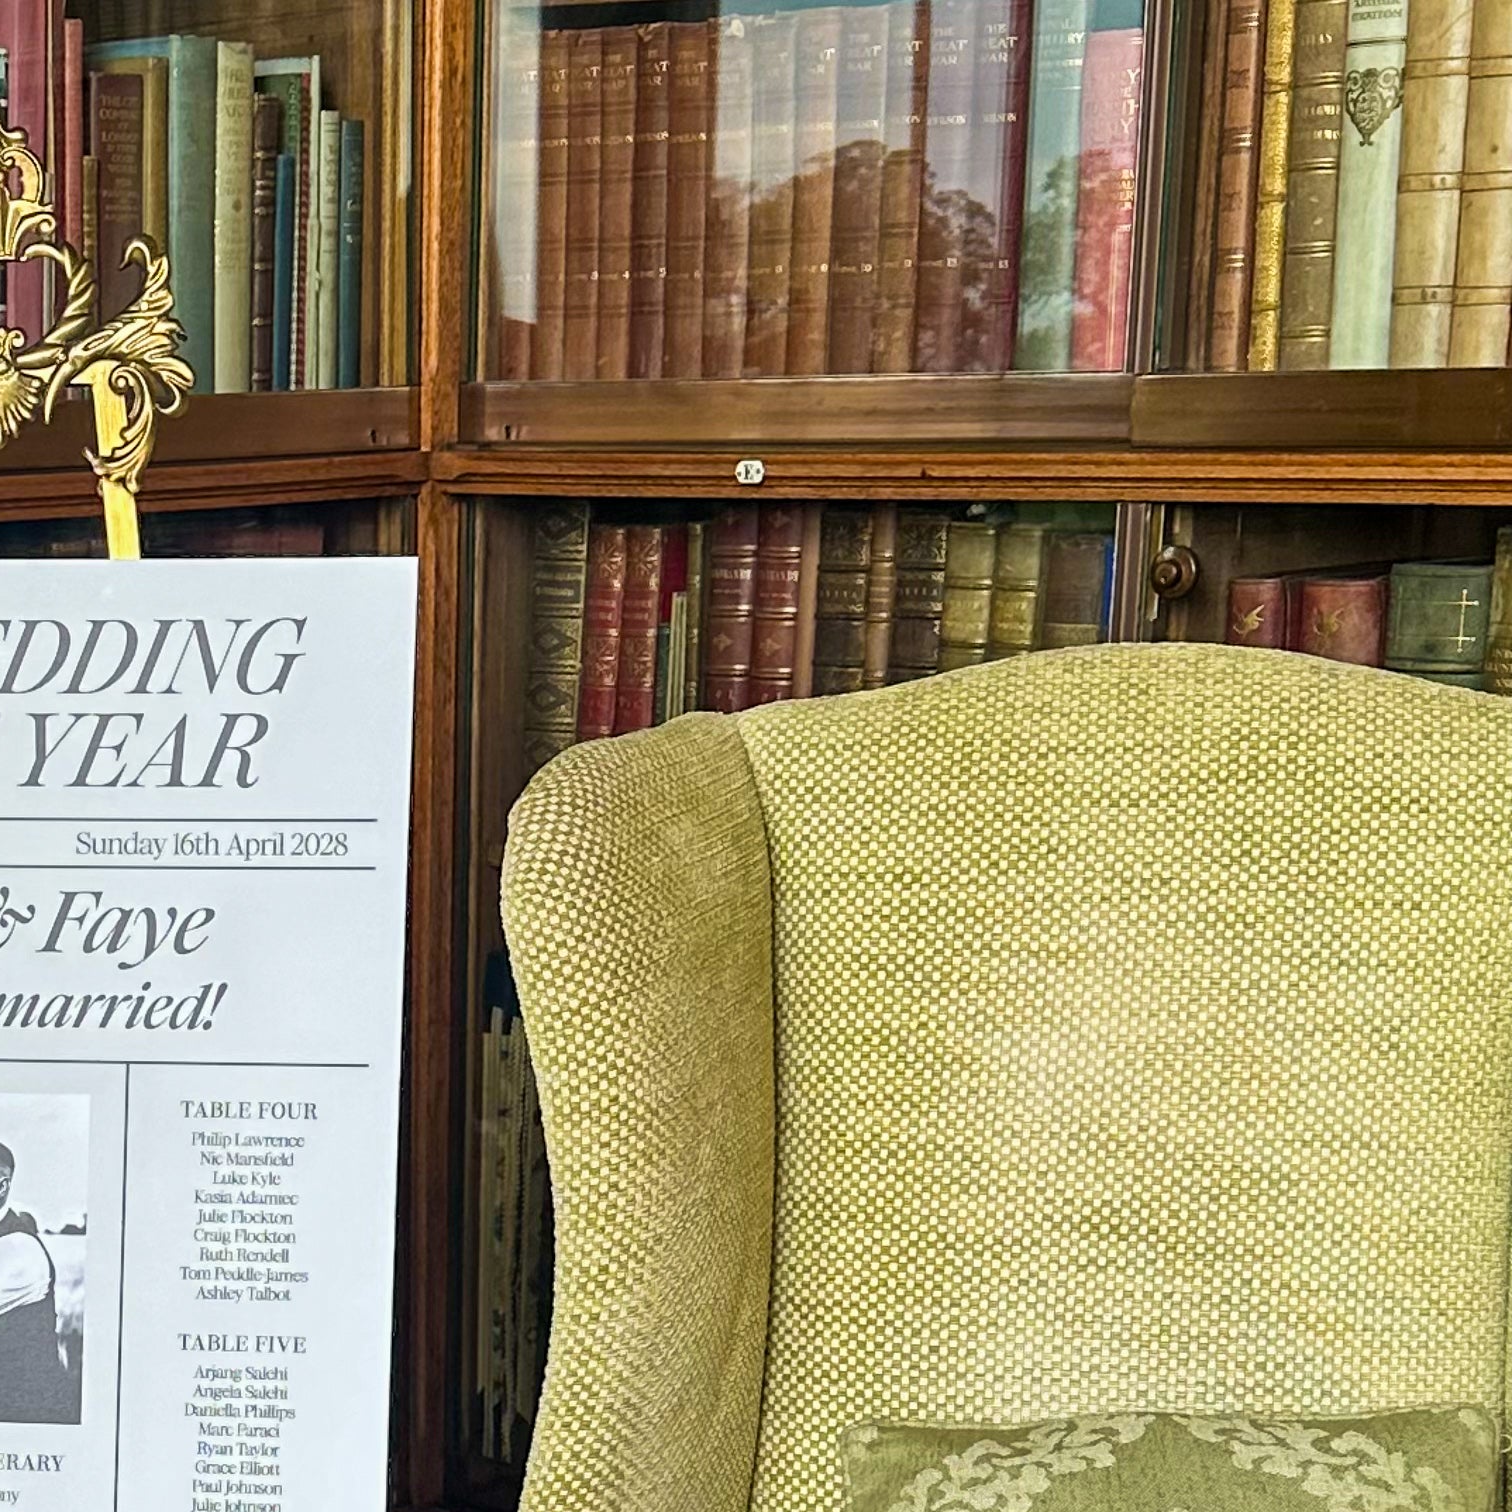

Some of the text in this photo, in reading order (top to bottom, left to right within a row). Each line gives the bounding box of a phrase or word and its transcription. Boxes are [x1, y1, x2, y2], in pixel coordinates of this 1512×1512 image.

[743, 463, 755, 480] E
[16, 713, 268, 788] YEAR
[76, 831, 348, 861] Sunday 16th April 2028
[36, 891, 215, 970] Faye
[180, 1100, 318, 1120] TABLE FOUR
[192, 1131, 305, 1149] Philip Lawrence
[200, 1151, 223, 1166] Nic
[212, 1171, 281, 1188] Luke Kyle
[196, 1209, 293, 1225] Julie Flockton
[193, 1228, 296, 1245] Craig Flockton
[200, 1247, 289, 1263] Ruth Rendell
[179, 1266, 211, 1280] Tom
[195, 1285, 292, 1304] Ashley Talbot
[178, 1333, 306, 1354] TABLE FIVE
[198, 1422, 234, 1436] Marc
[197, 1441, 280, 1458] Ryan Taylor
[195, 1460, 280, 1476] Grace Elliott
[192, 1479, 282, 1496] Paul Johnson
